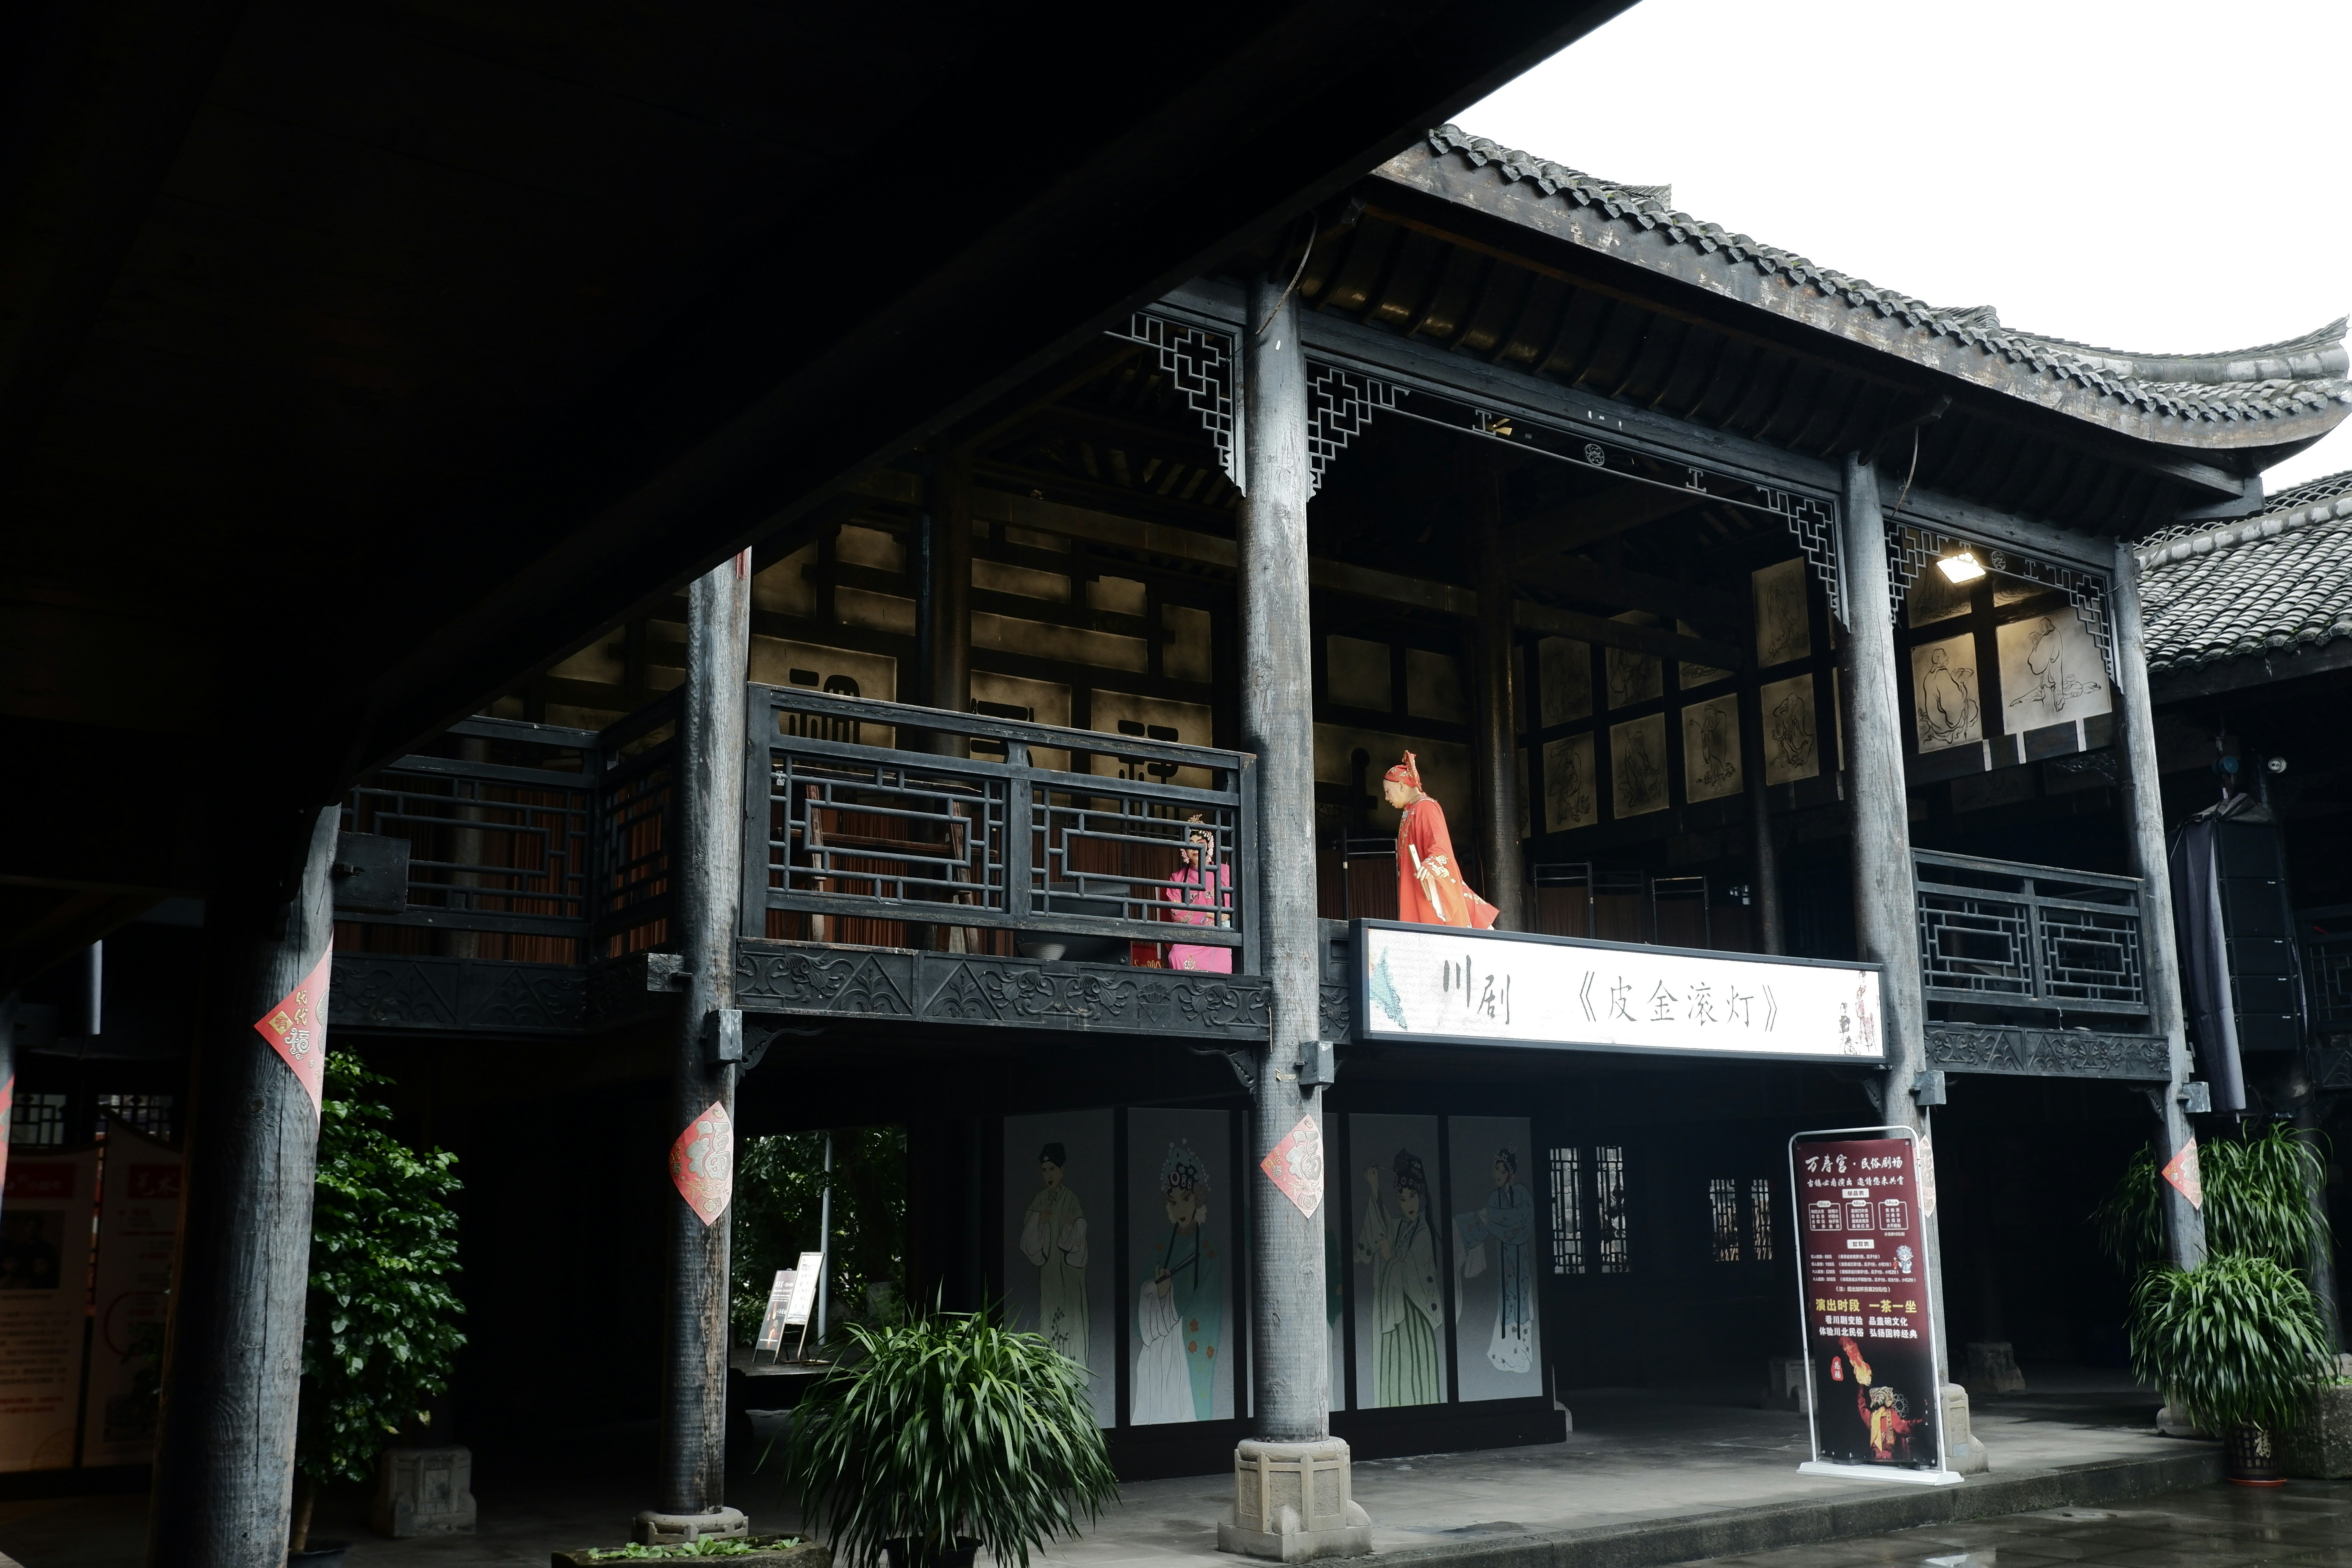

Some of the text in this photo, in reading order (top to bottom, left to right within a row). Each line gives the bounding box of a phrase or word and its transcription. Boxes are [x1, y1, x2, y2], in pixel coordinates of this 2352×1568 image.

[1443, 955, 1777, 1032] 川剧 《皮金滚灯》
[685, 1120, 731, 1181] 福
[1285, 1131, 1321, 1181] 福
[1816, 1298, 1917, 1313] 演出时段 一茶一坐
[1825, 1315, 1908, 1326] 看川剧变脸 品盖碗文化
[1819, 1327, 1918, 1339] 体验川北民俗 弘扬国粹经典
